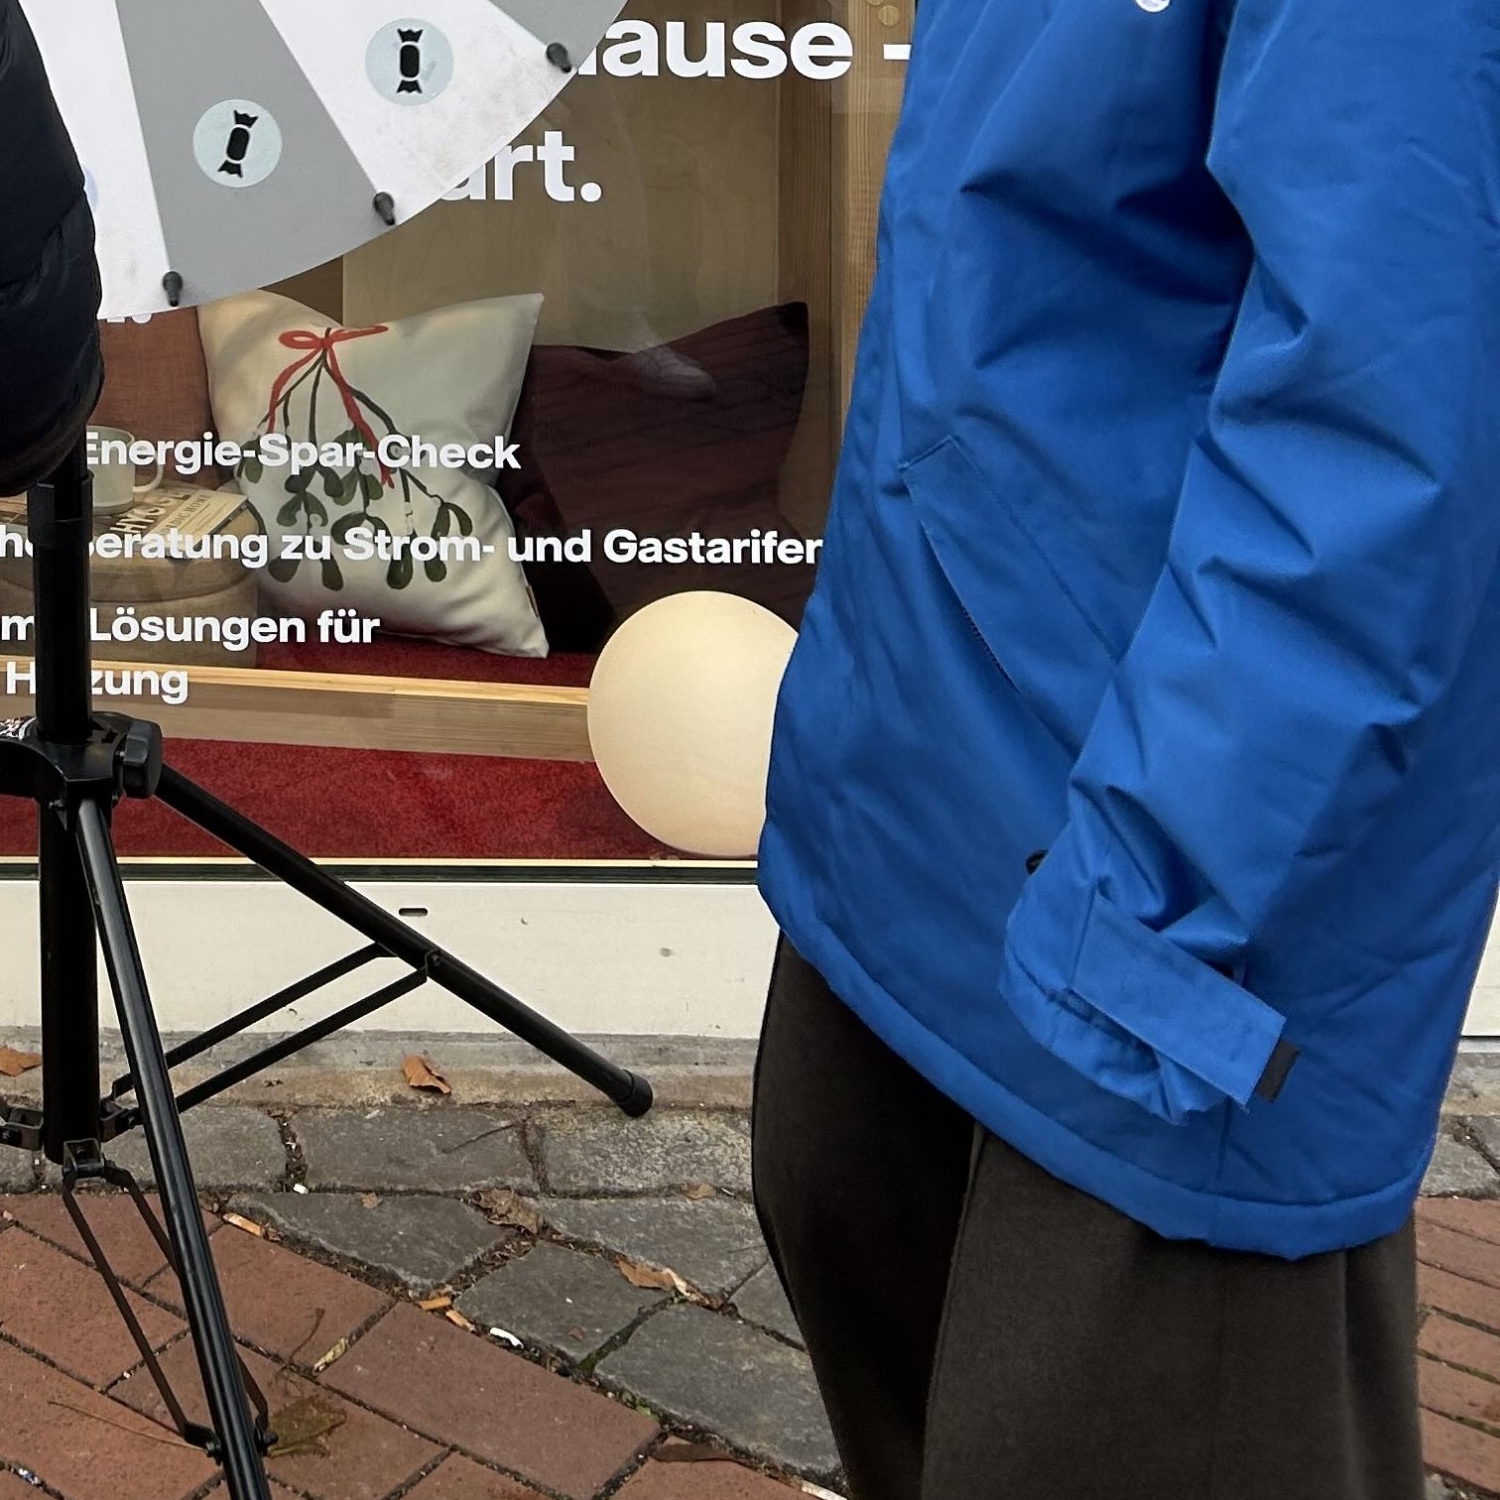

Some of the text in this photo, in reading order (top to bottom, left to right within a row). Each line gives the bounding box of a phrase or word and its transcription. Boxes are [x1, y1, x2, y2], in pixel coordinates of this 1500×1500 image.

[578, 19, 853, 80] ause
[86, 431, 521, 475] Energie-Spar-Check
[88, 524, 268, 569] eratung
[280, 535, 331, 560] zu
[343, 527, 495, 562] Strom-
[507, 529, 592, 563] und
[89, 606, 306, 651] Lösungen
[317, 609, 381, 644] für
